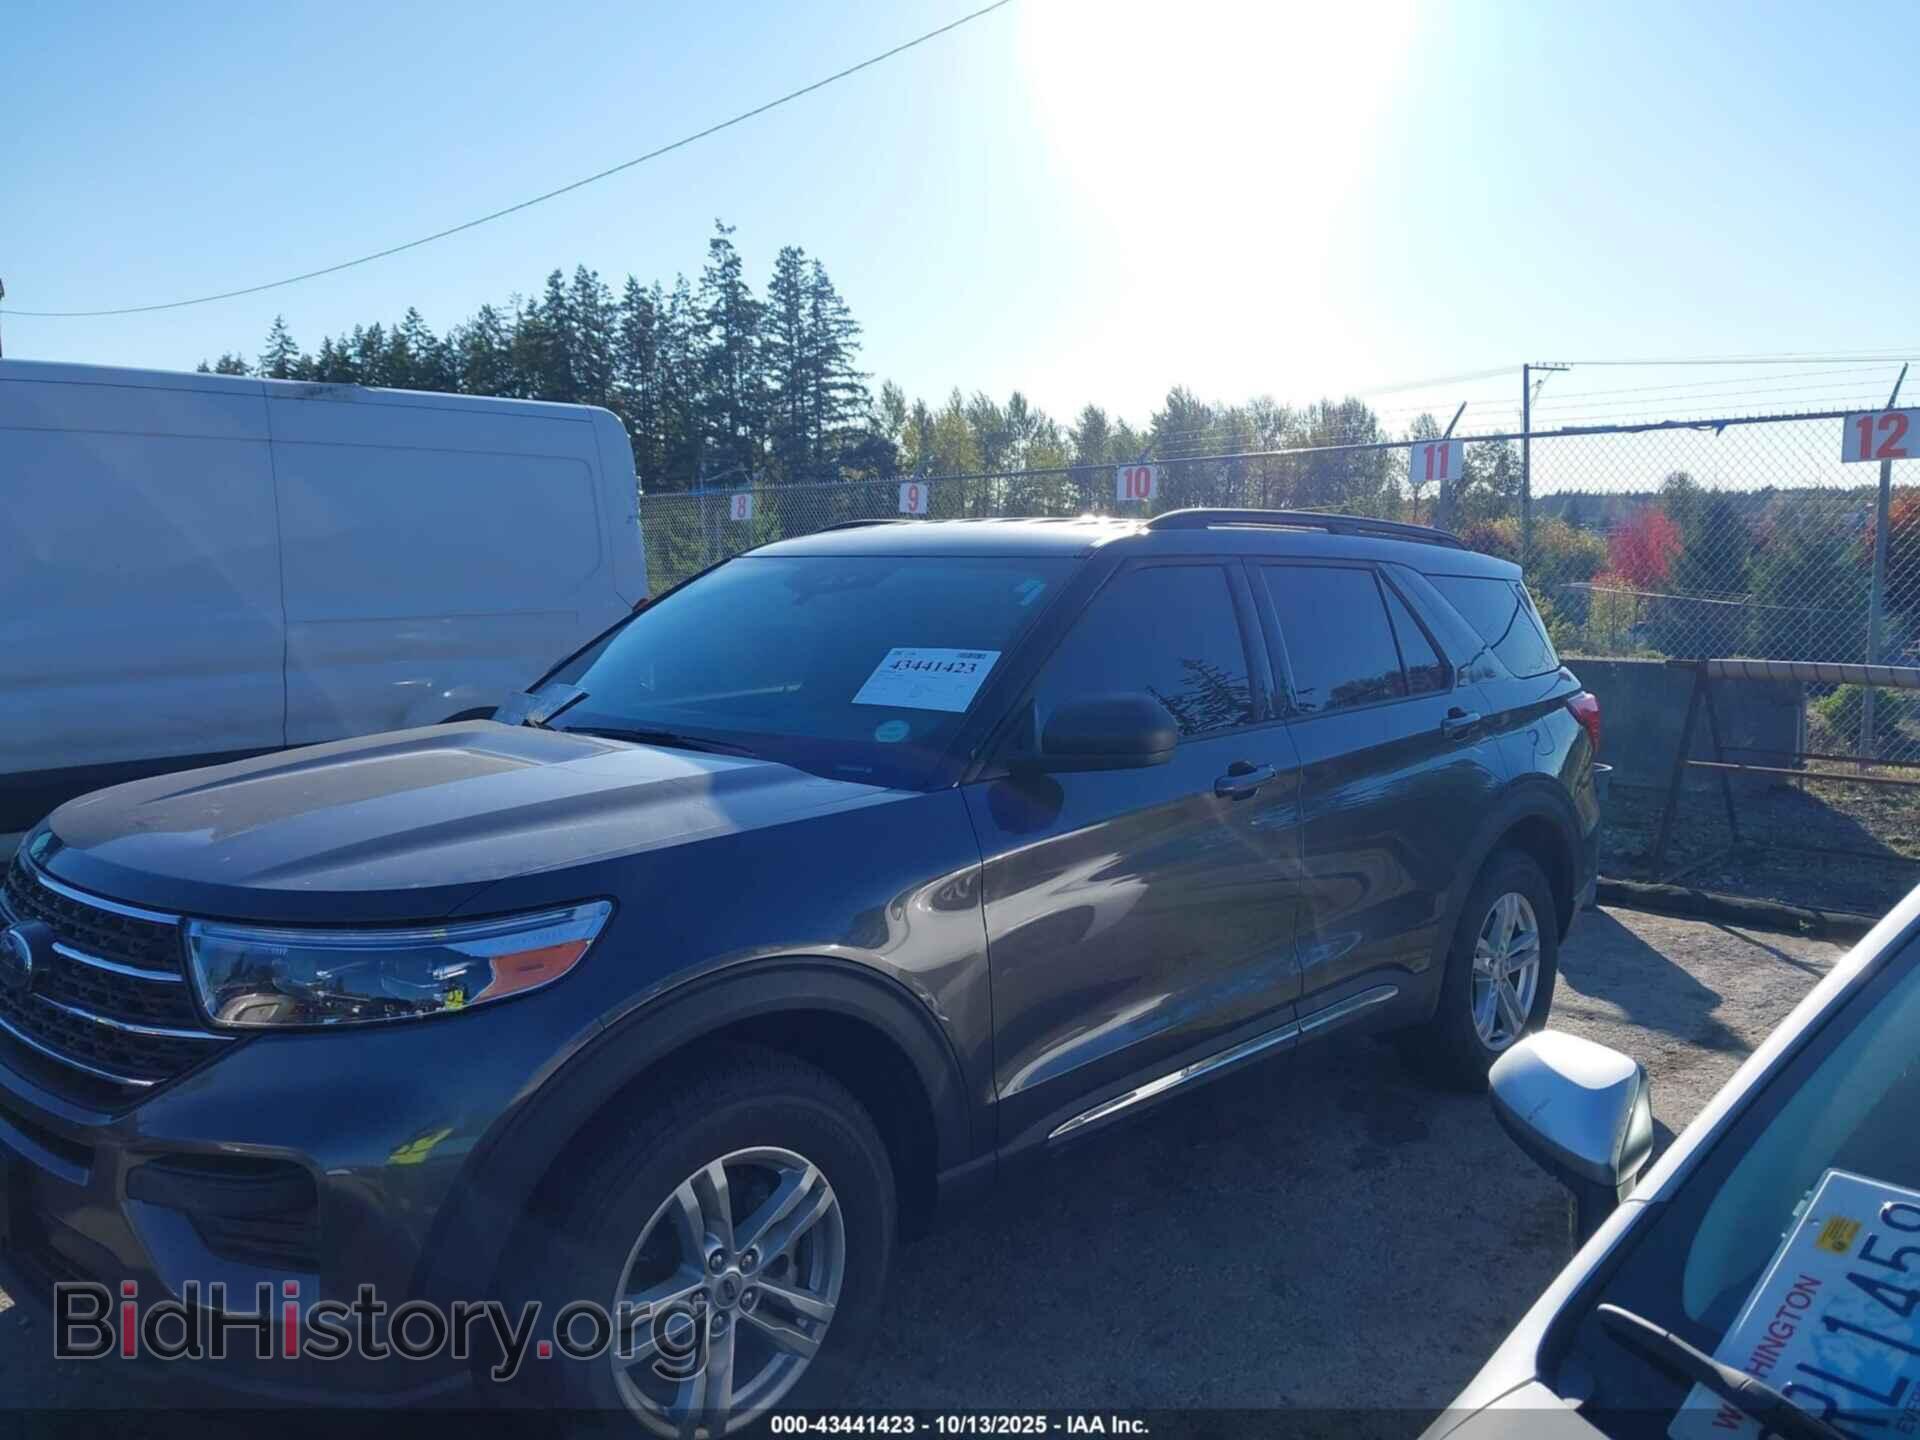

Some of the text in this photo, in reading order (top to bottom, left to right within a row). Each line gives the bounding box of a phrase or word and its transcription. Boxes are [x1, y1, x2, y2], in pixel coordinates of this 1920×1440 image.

[1856, 413, 1909, 459] 12
[1424, 443, 1450, 480] 11
[1124, 467, 1150, 497] 10
[736, 495, 746, 518] 8
[908, 484, 918, 512] 9
[889, 659, 977, 674] 43441423
[1711, 1274, 1823, 1431] WHINGTON
